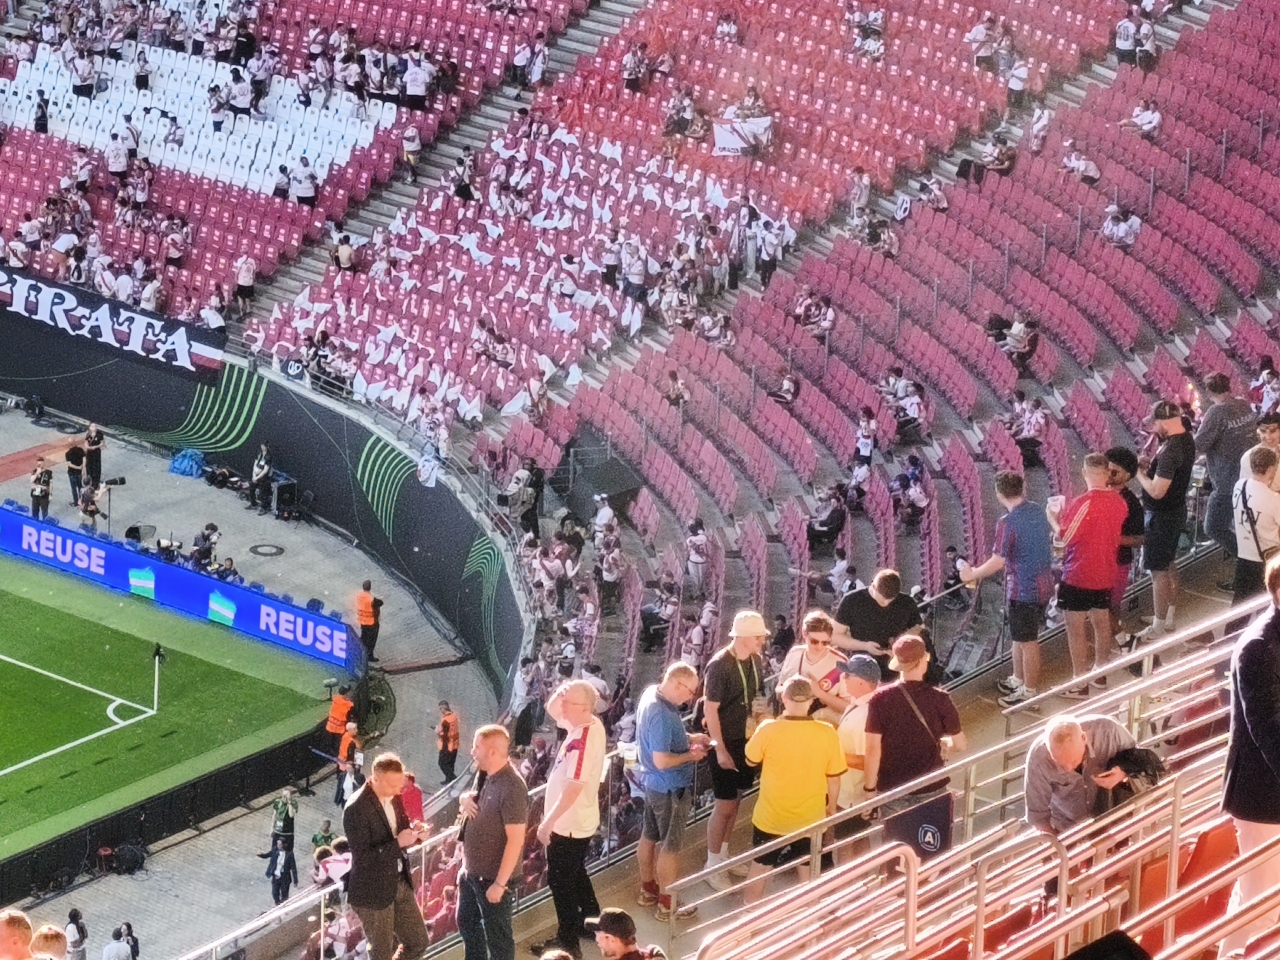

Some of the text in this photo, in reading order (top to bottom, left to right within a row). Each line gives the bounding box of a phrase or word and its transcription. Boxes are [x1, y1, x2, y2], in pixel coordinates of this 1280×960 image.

[22, 524, 106, 575] REUSE
[259, 604, 347, 659] REUSE
[924, 831, 935, 845] A
